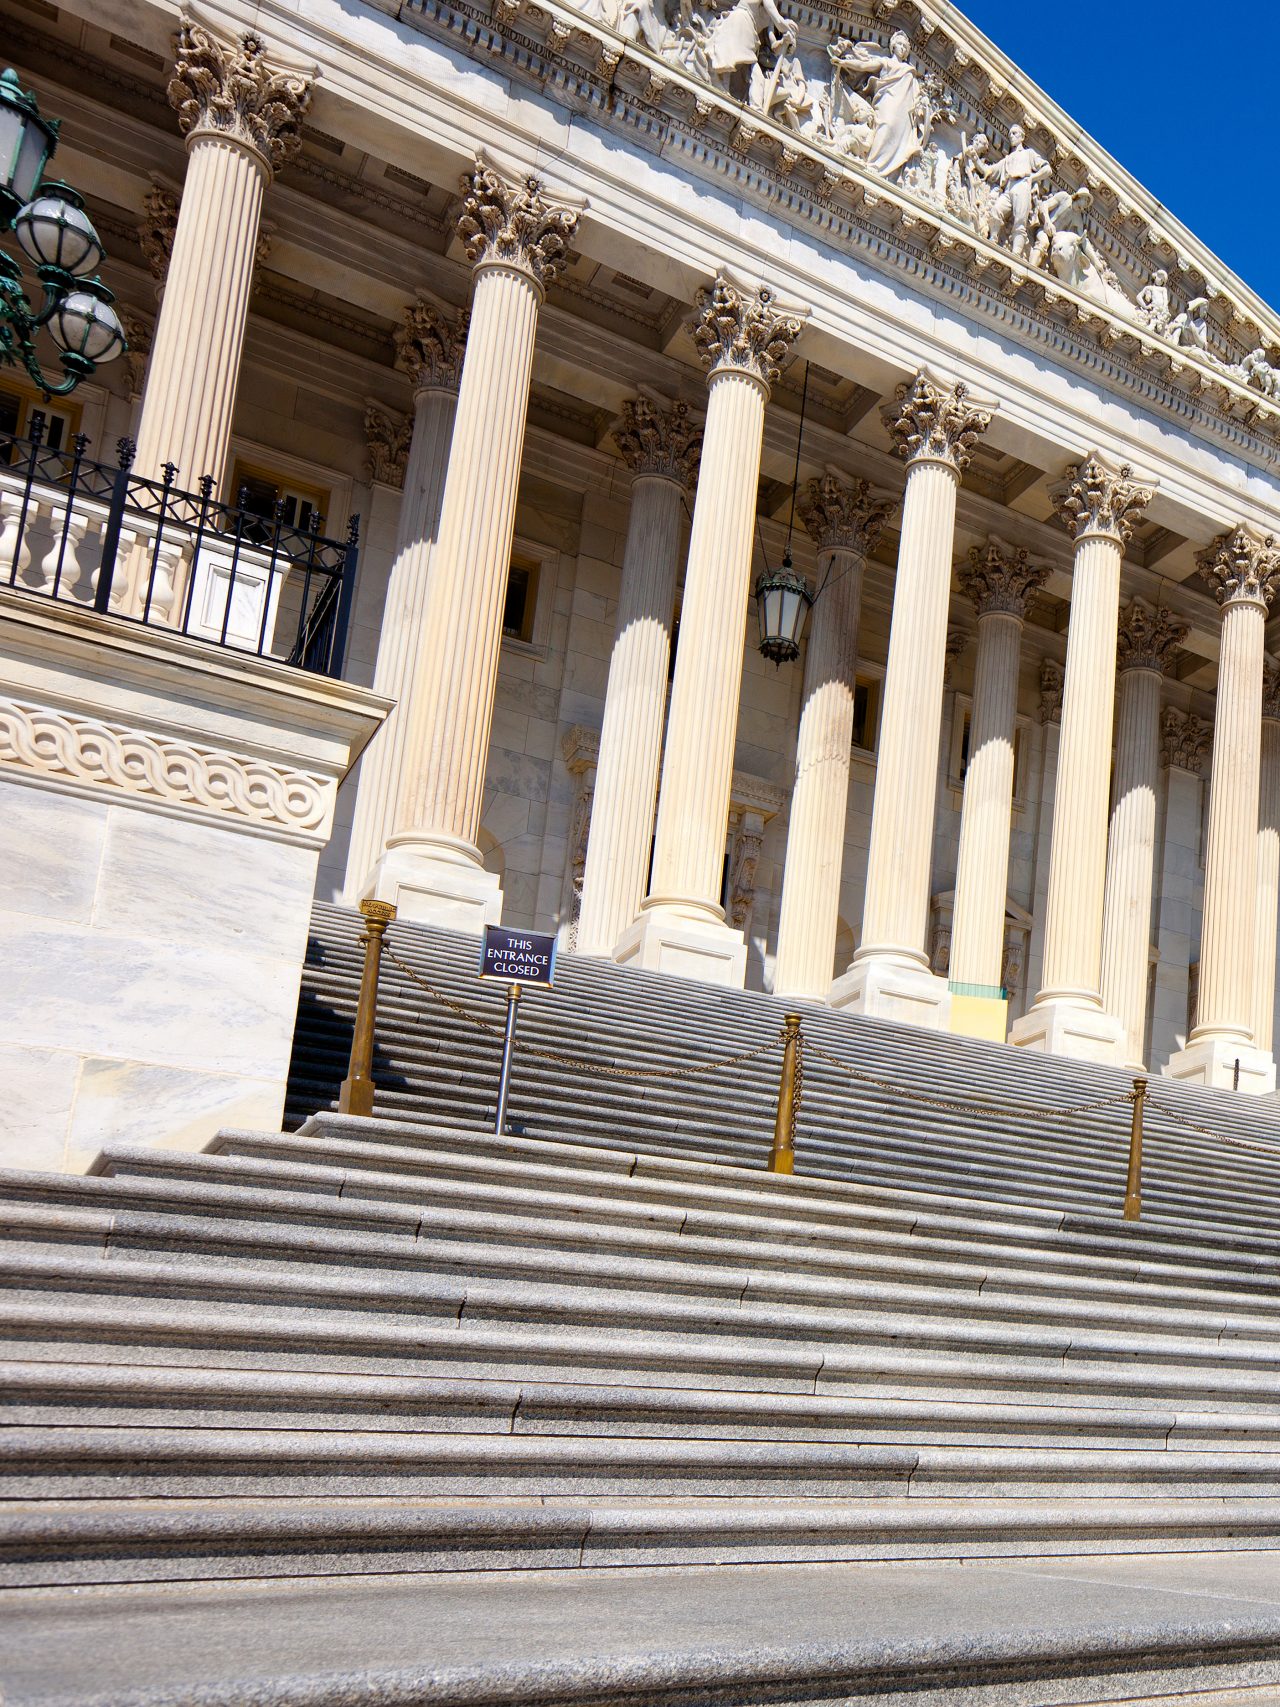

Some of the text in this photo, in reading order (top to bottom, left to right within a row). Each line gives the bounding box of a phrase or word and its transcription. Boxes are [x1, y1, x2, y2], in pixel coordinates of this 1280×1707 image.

[507, 938, 533, 950] THIS
[487, 948, 549, 966] ENTRANCE
[494, 962, 540, 976] CLOSED
